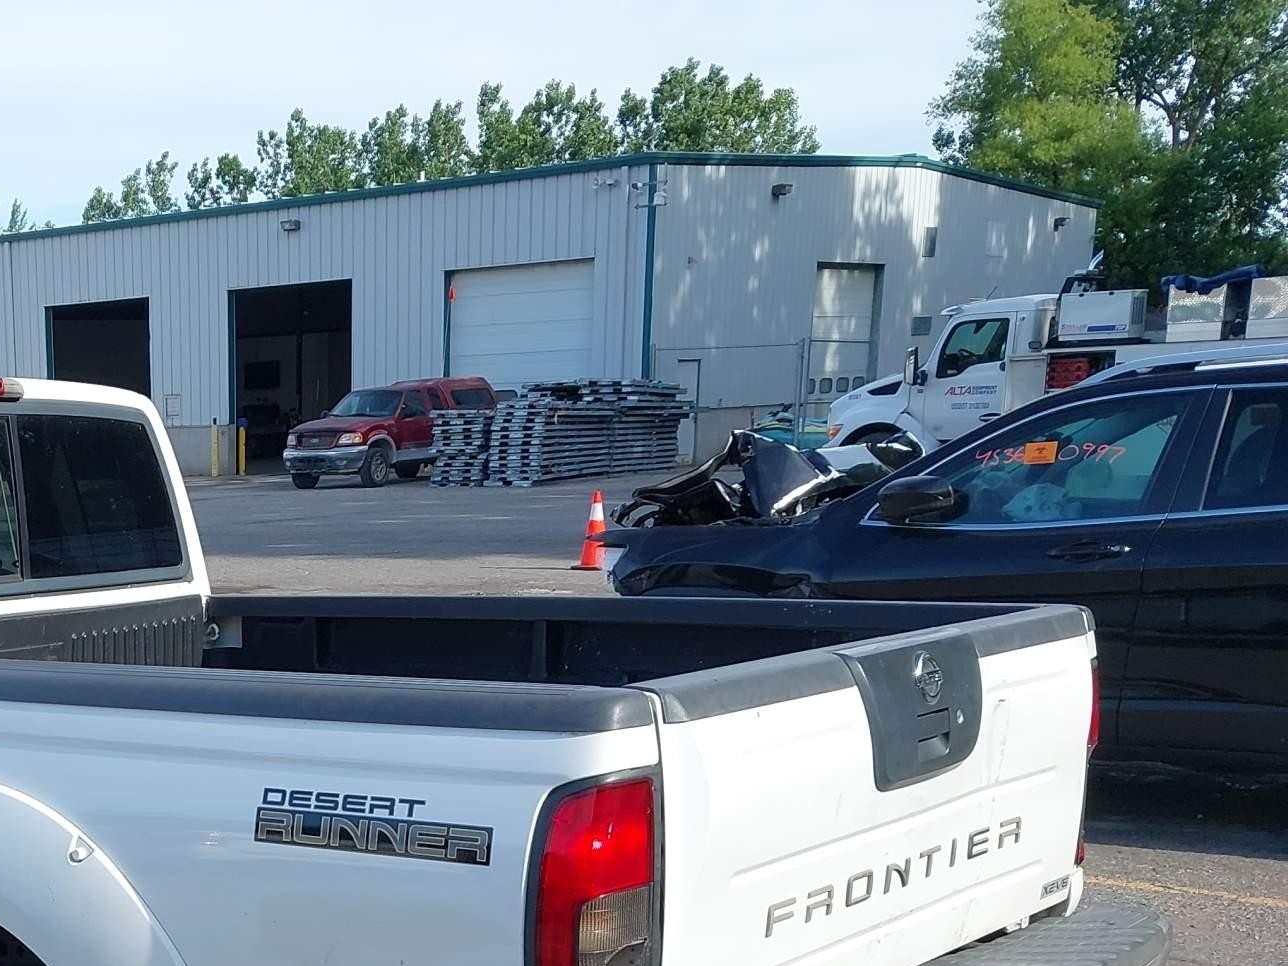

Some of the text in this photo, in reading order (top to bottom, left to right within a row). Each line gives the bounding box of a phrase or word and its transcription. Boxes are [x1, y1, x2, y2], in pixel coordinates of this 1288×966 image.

[944, 385, 972, 396] ALTA
[1058, 442, 1127, 465] 0997
[262, 787, 426, 818] DESERT
[257, 810, 489, 862] RUNNER
[765, 816, 1022, 938] FRONTIER
